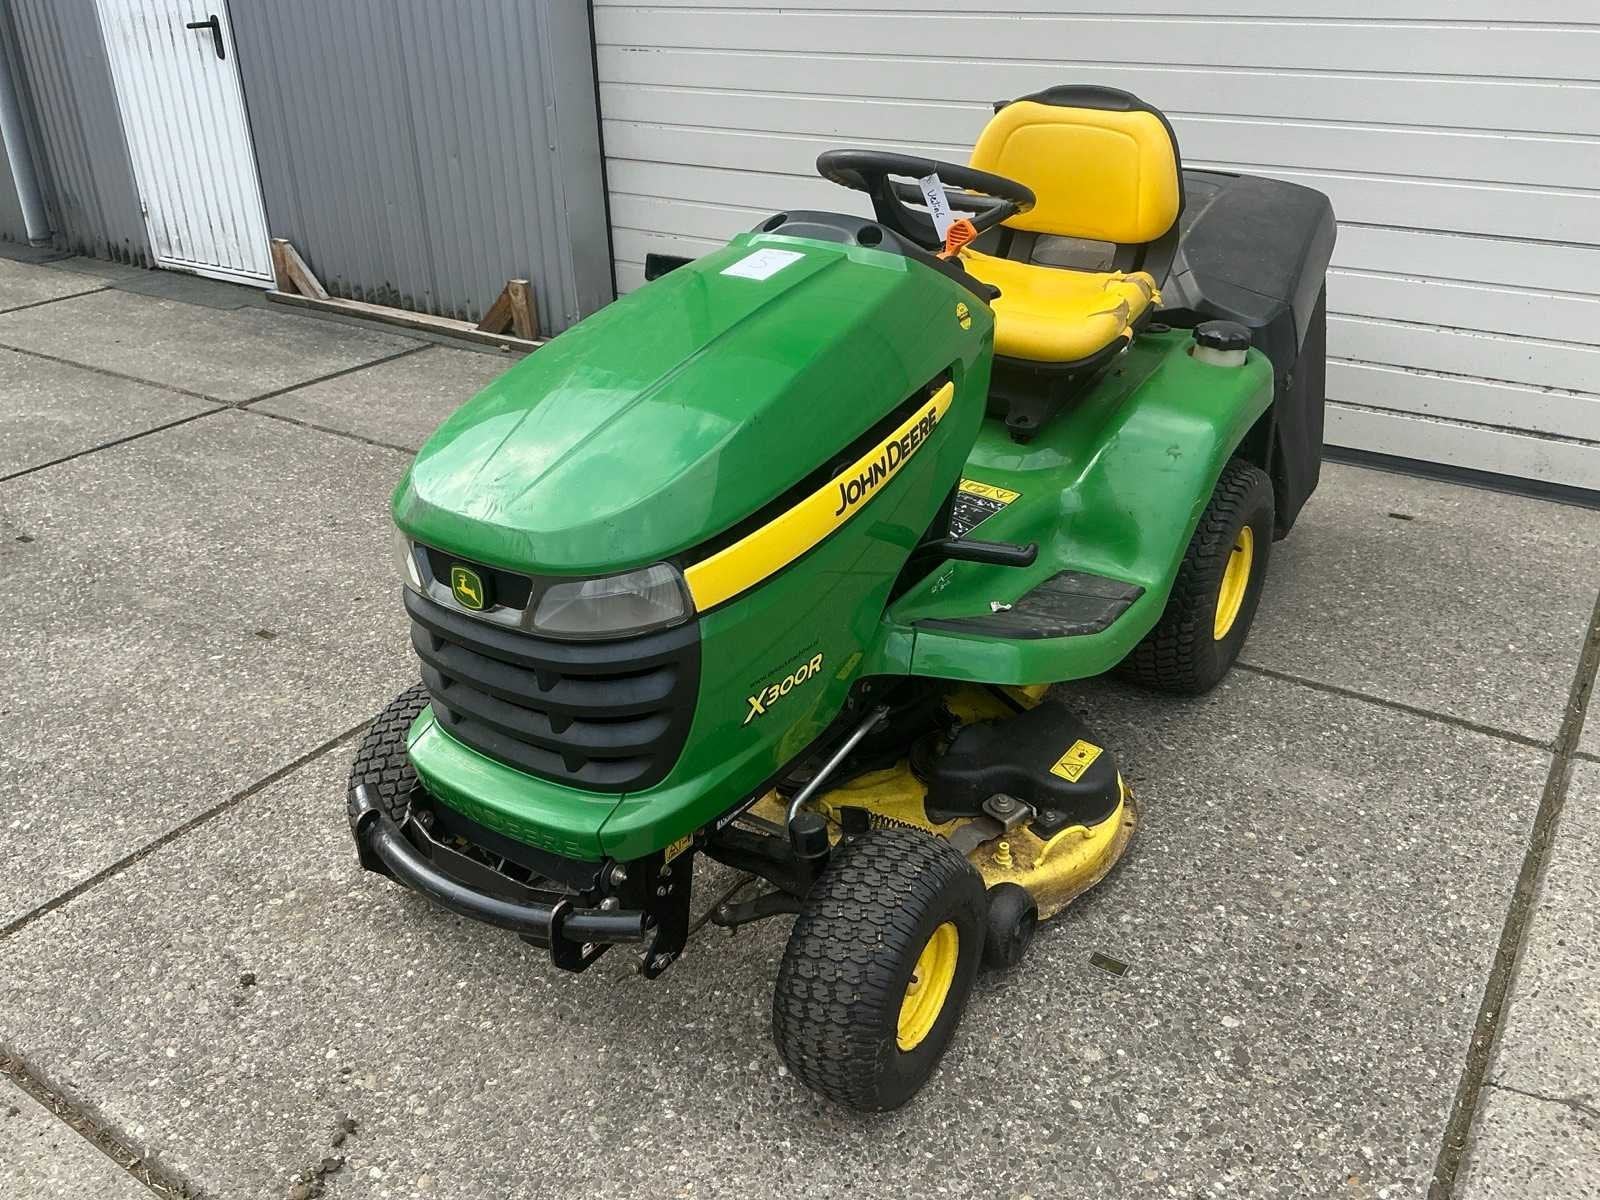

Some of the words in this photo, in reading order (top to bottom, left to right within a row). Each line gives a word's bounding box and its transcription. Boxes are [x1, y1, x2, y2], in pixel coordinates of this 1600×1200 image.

[836, 455, 887, 516] JOHN
[886, 406, 937, 472] DEERE
[742, 652, 823, 725] X300R
